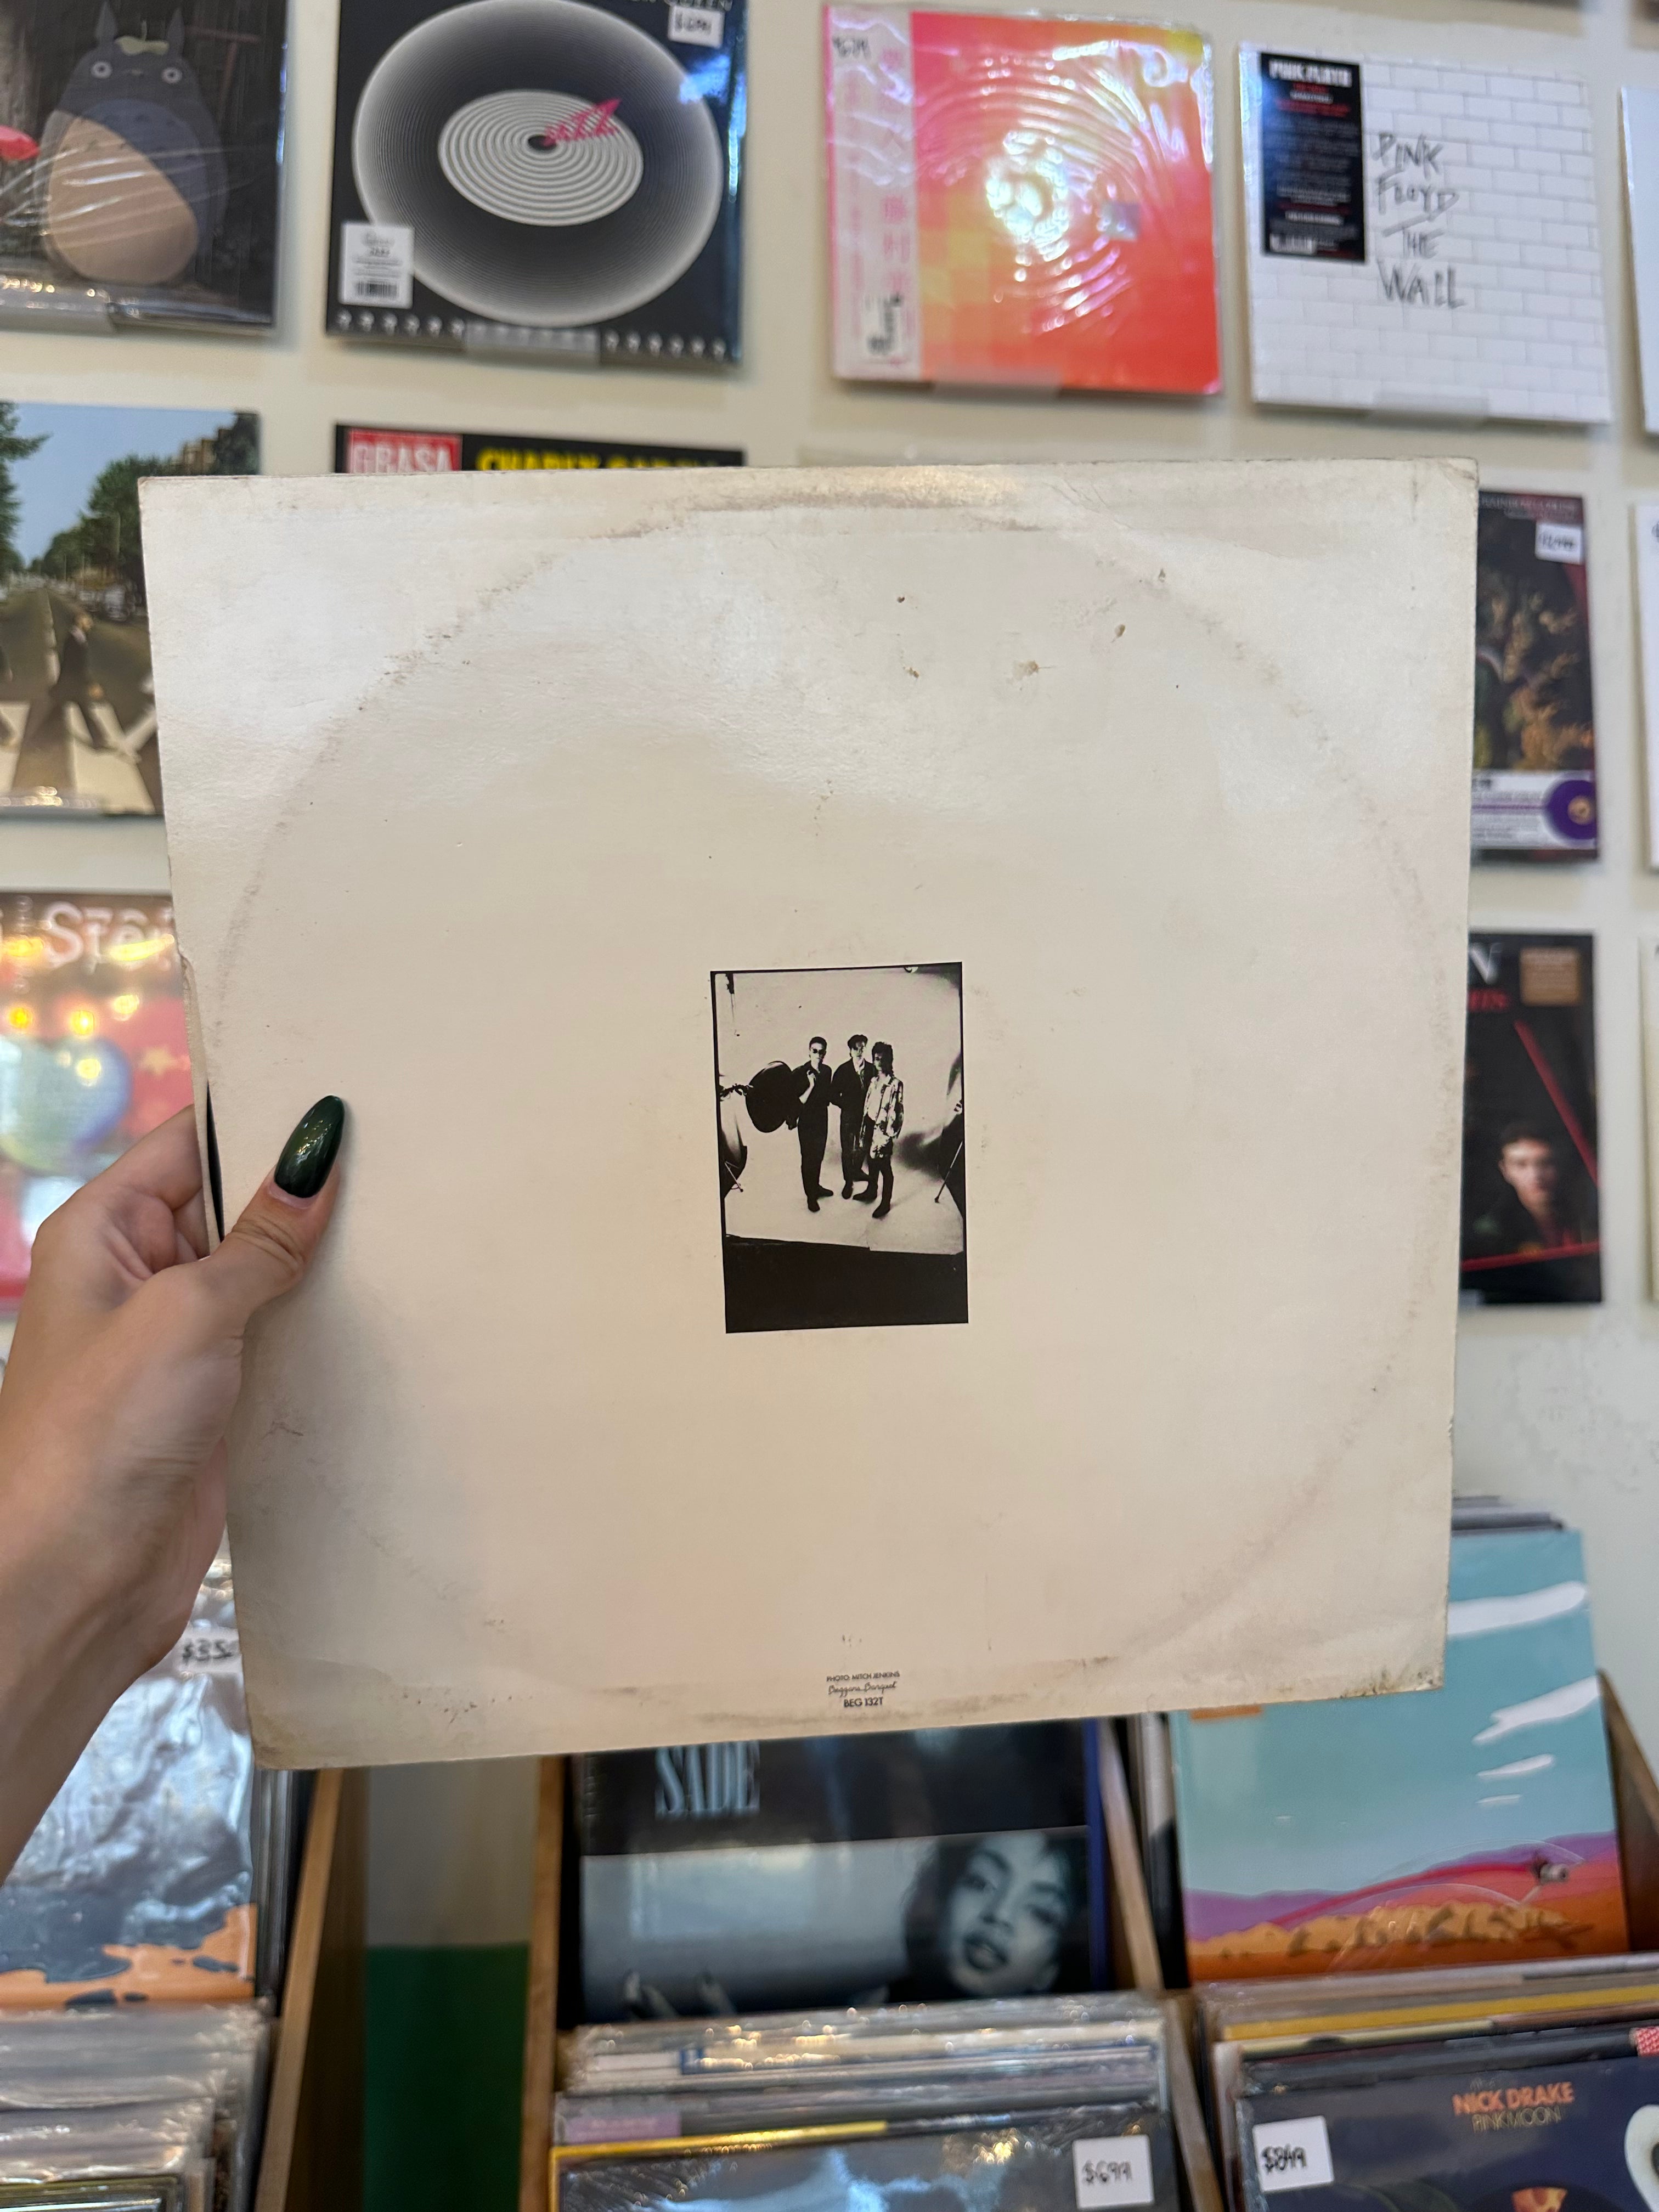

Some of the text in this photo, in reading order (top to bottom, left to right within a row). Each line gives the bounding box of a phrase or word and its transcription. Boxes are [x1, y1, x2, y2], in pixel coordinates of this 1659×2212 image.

[1372, 132, 1444, 180] PINK
[1376, 166, 1460, 221] FLOYD
[1383, 216, 1446, 259] THE
[1377, 259, 1468, 308] WALL
[828, 1681, 898, 1698] Beggars Banquet
[873, 1671, 900, 1679] JENKINS
[844, 1696, 883, 1708] BEG 132T
[1452, 2090, 1504, 2115] NICK
[1505, 2081, 1575, 2110] DRAKE
